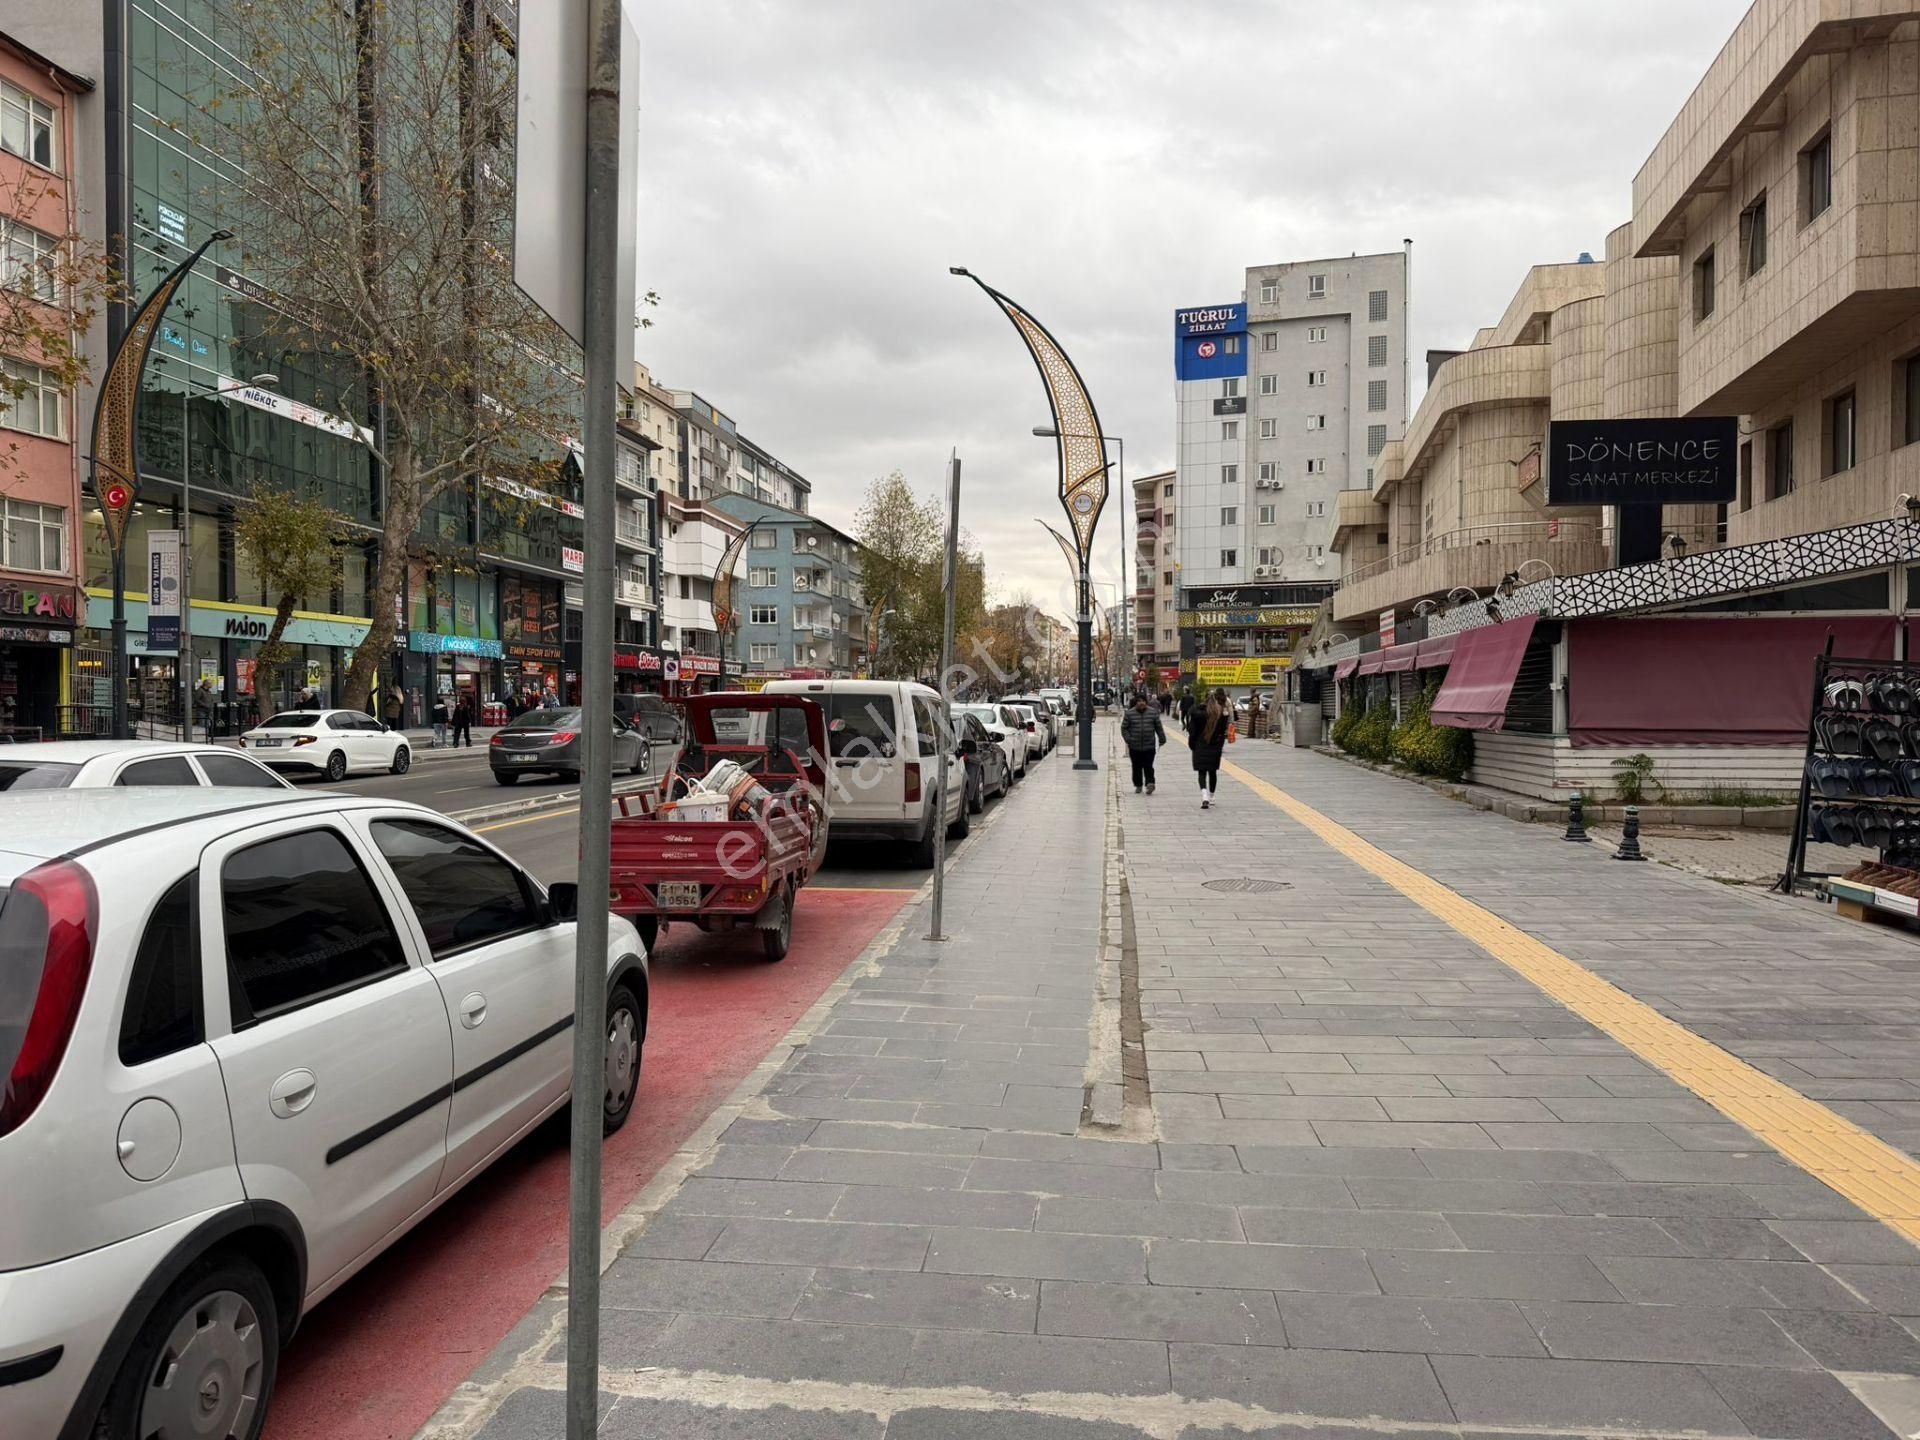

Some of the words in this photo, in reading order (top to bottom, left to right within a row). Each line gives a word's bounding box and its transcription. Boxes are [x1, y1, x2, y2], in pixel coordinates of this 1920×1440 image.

[1178, 307, 1238, 325] TUĞRUL
[1188, 320, 1227, 333] ZİRAAT
[1567, 436, 1721, 463] DÖNENCE
[1568, 472, 1632, 488] SANAT
[1634, 466, 1720, 487] MERKEZİ
[225, 615, 267, 638] mion
